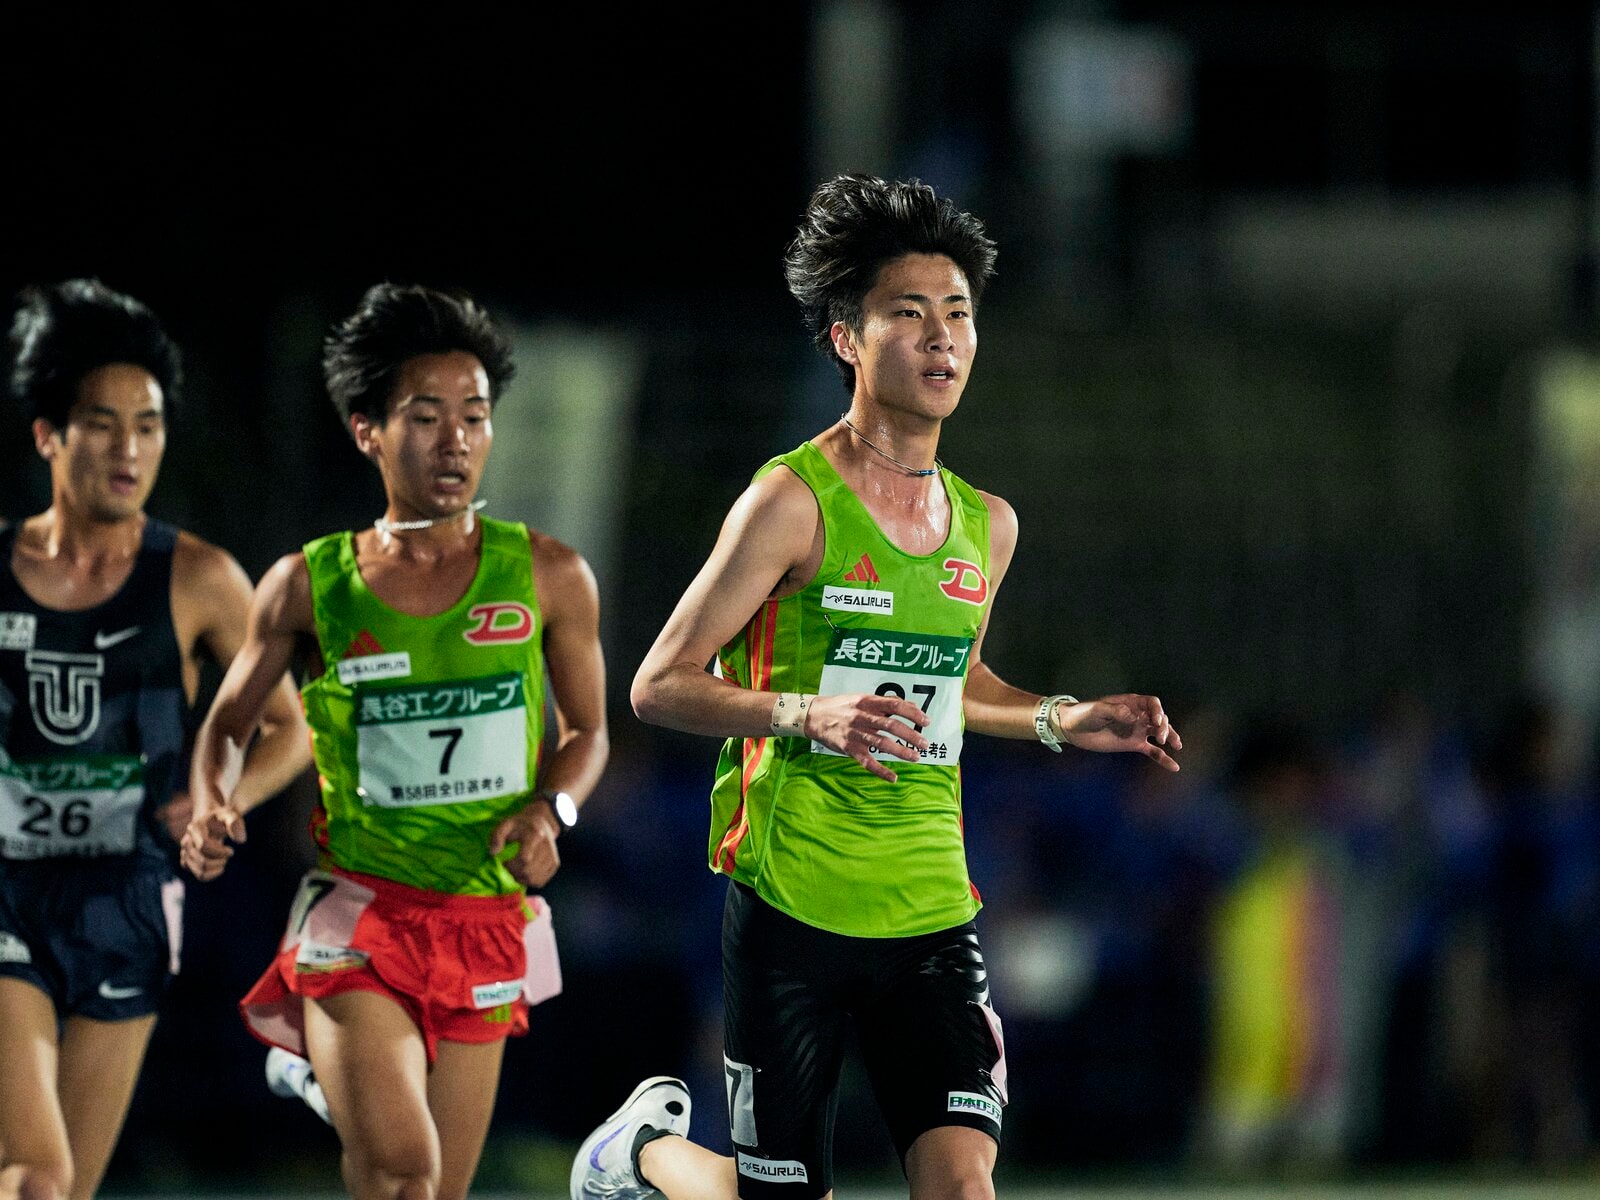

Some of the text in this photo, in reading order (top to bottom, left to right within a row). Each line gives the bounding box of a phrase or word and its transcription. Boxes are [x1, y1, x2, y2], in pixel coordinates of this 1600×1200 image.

[843, 595, 892, 609] SAURUS
[428, 727, 464, 776] 7
[19, 796, 92, 838] 26
[298, 879, 337, 934] 7
[752, 1163, 806, 1178] SAURUS
